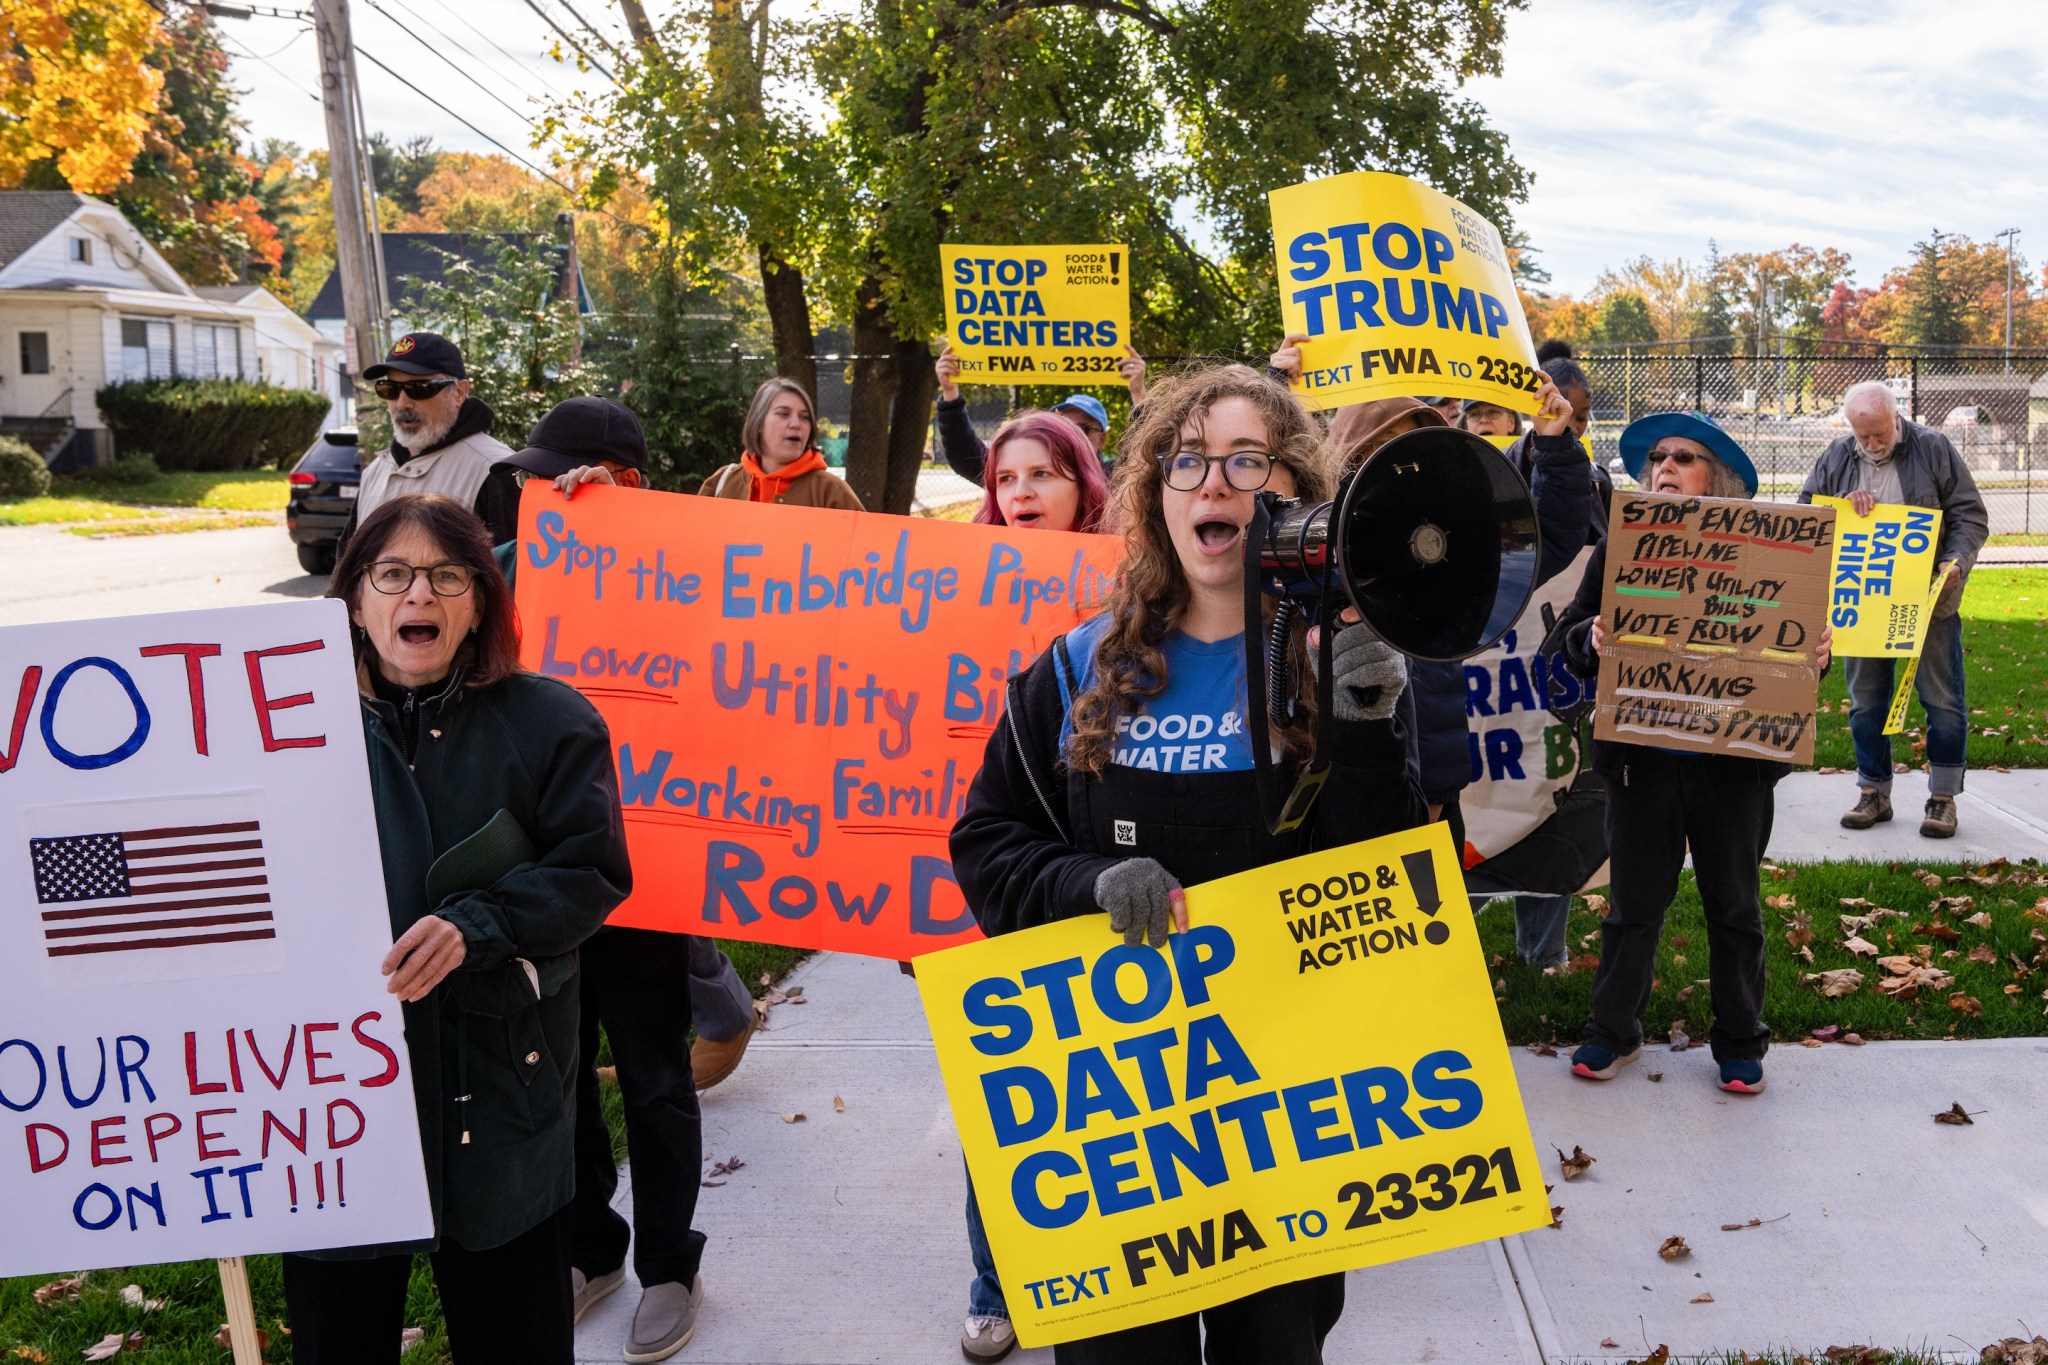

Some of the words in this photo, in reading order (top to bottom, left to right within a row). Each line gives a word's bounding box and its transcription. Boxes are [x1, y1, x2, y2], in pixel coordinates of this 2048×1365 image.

[1289, 222, 1455, 282] STOP
[1455, 222, 1490, 249] WATER
[954, 258, 1047, 286] STOP
[1066, 265, 1103, 274] WATER
[1066, 276, 1109, 285] ACTION
[955, 288, 1046, 316] DATA
[1292, 277, 1509, 339] TRUMP
[958, 319, 1118, 347] CENTERS
[957, 359, 983, 371] TEXT
[988, 356, 1035, 371] FWA
[1041, 361, 1058, 371] TO
[1303, 365, 1353, 389] TEXT
[1361, 348, 1442, 378] FWA
[1447, 361, 1472, 378] TO
[1477, 355, 1539, 393] 2332
[1622, 499, 1701, 524] STOP
[1699, 506, 1835, 547] ENBRIDGE
[1902, 511, 1935, 554] NO
[1634, 532, 1743, 562] PIPELINE
[1864, 522, 1901, 596] RATE
[526, 510, 617, 600] Stop
[627, 549, 702, 605] the
[722, 529, 959, 634] Enbridge
[979, 542, 1116, 624] Pipelin
[1615, 565, 1699, 594] LOWER
[1706, 570, 1787, 601] UTILITY
[1831, 533, 1868, 629] HIKES
[1687, 618, 1764, 644] ROW
[1775, 619, 1807, 648] D
[1898, 604, 1909, 636] WATER
[540, 614, 692, 689] Lower
[711, 641, 920, 760] Utility
[944, 649, 1042, 724] Bil
[1617, 660, 1756, 699] WORKING
[1114, 714, 1214, 741] FOOD
[1613, 697, 1721, 735] FAMILIES
[1111, 743, 1228, 771] WATER
[618, 743, 821, 857] Working
[833, 758, 966, 821] Famili
[702, 841, 892, 925] Row
[909, 855, 976, 935] D
[1279, 870, 1371, 915] FOOD
[1287, 897, 1397, 944] WATER
[1298, 922, 1418, 974] ACTION
[962, 924, 1236, 1056] STOP
[0, 1033, 157, 1112] OUR
[184, 1011, 400, 1097] LIVES
[980, 1014, 1261, 1148] DATA
[25, 1098, 366, 1174] DEPEND
[1011, 1049, 1485, 1230] CENTERS
[73, 1180, 166, 1231] ON
[1025, 1266, 1112, 1310] TEXT
[1120, 1209, 1267, 1288] FWA
[1276, 1209, 1329, 1245] TO
[1337, 1146, 1522, 1232] 23321
